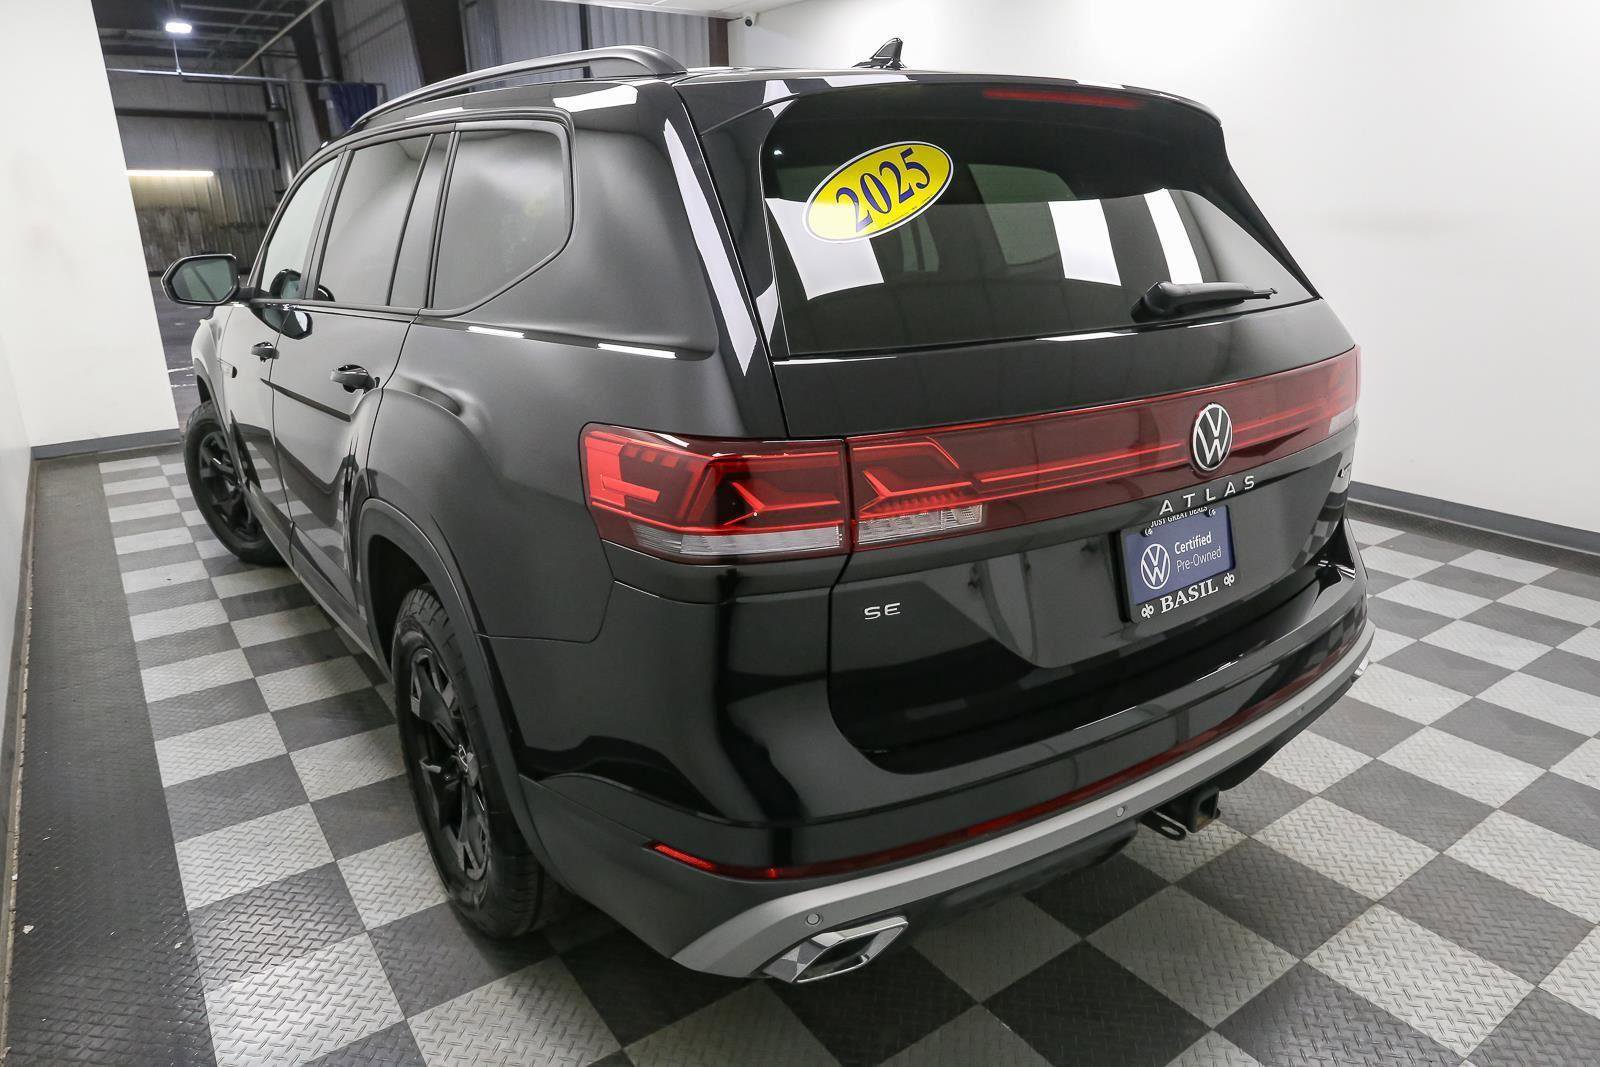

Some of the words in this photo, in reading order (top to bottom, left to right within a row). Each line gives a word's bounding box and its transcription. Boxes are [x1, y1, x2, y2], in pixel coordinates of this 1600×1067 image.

[835, 147, 931, 233] 2025
[1159, 475, 1255, 516] ATLAS
[1150, 518, 1166, 528] JUST
[1167, 512, 1188, 523] GREAT
[1174, 531, 1212, 555] Certified
[1176, 546, 1222, 573] Pre-Owned
[1160, 578, 1219, 614] BASIL
[864, 602, 901, 620] SE
